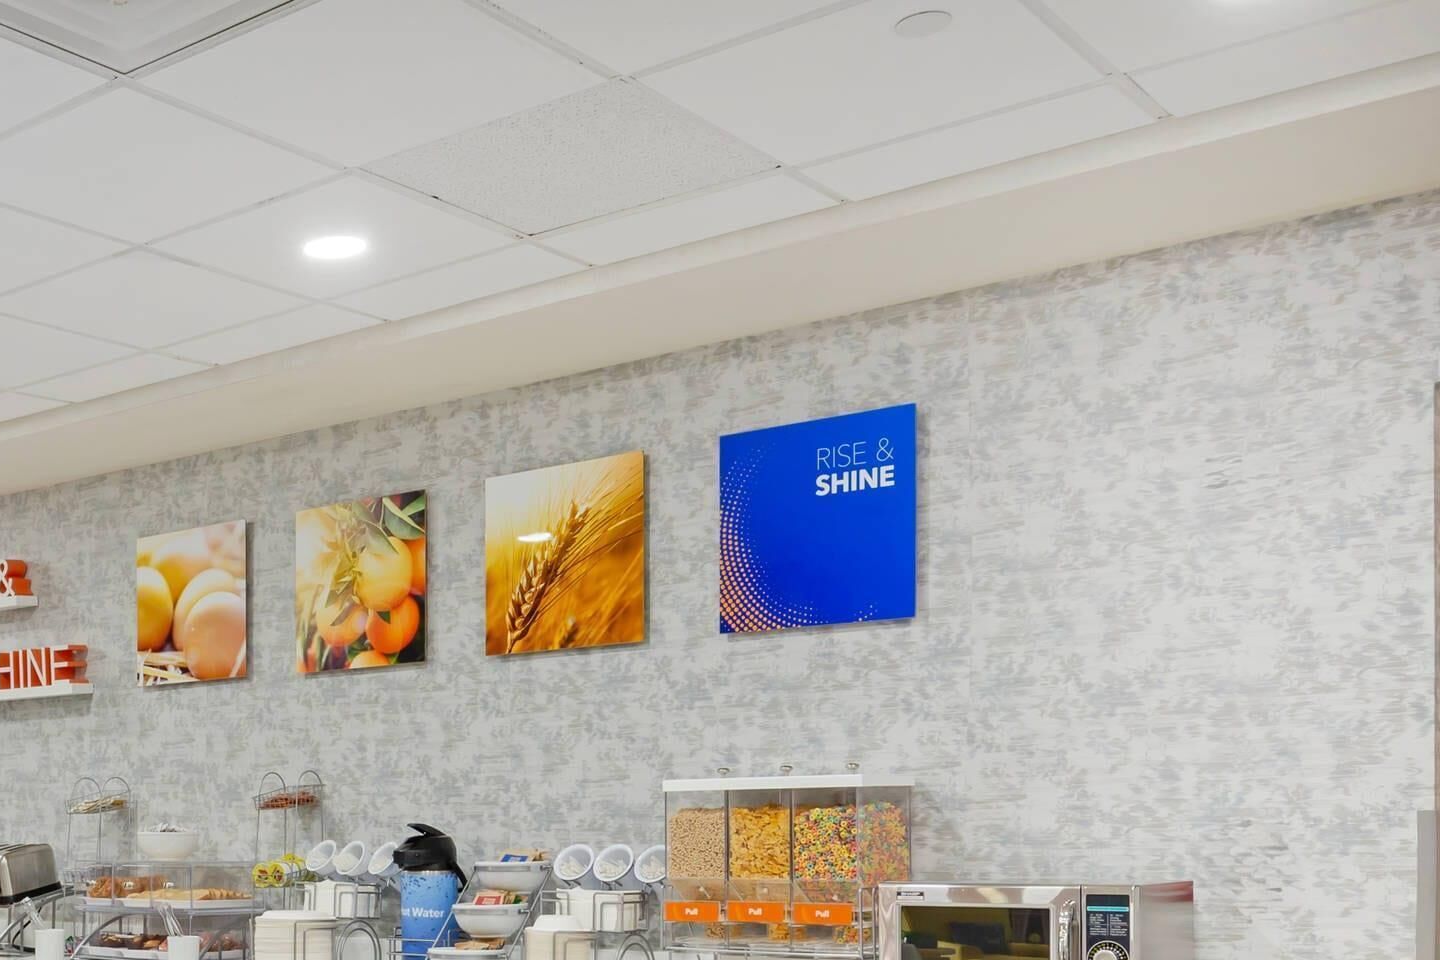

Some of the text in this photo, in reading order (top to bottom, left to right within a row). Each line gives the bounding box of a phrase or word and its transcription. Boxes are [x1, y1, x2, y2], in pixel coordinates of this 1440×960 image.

[816, 437, 894, 470] RISE &
[815, 464, 895, 497] SHINE
[411, 907, 445, 918] Water
[684, 907, 699, 916] Pull
[748, 907, 762, 916] Pull
[815, 909, 830, 918] Pull
